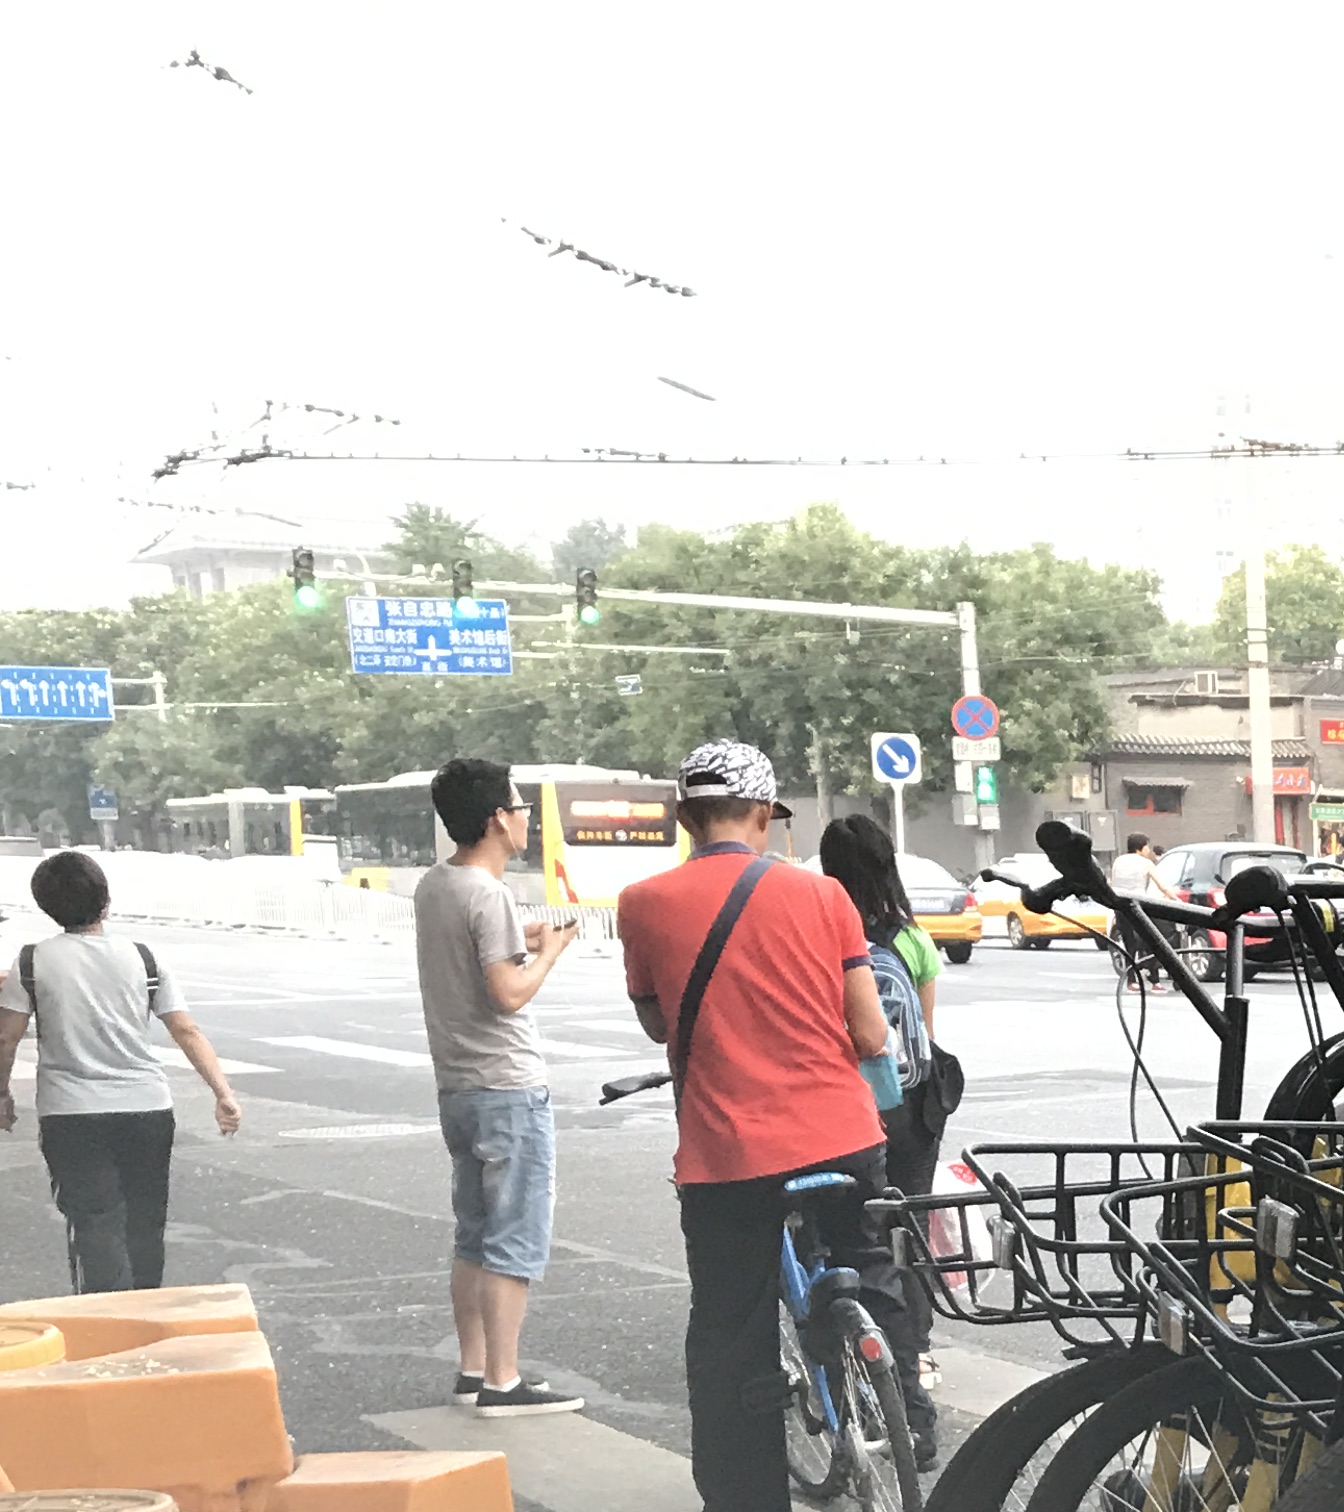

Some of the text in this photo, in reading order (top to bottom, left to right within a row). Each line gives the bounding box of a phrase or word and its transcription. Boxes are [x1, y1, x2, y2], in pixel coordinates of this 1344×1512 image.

[385, 601, 453, 617] 张自忠路
[353, 628, 418, 645] 交道口南大街
[449, 629, 508, 646] 美术馆后街
